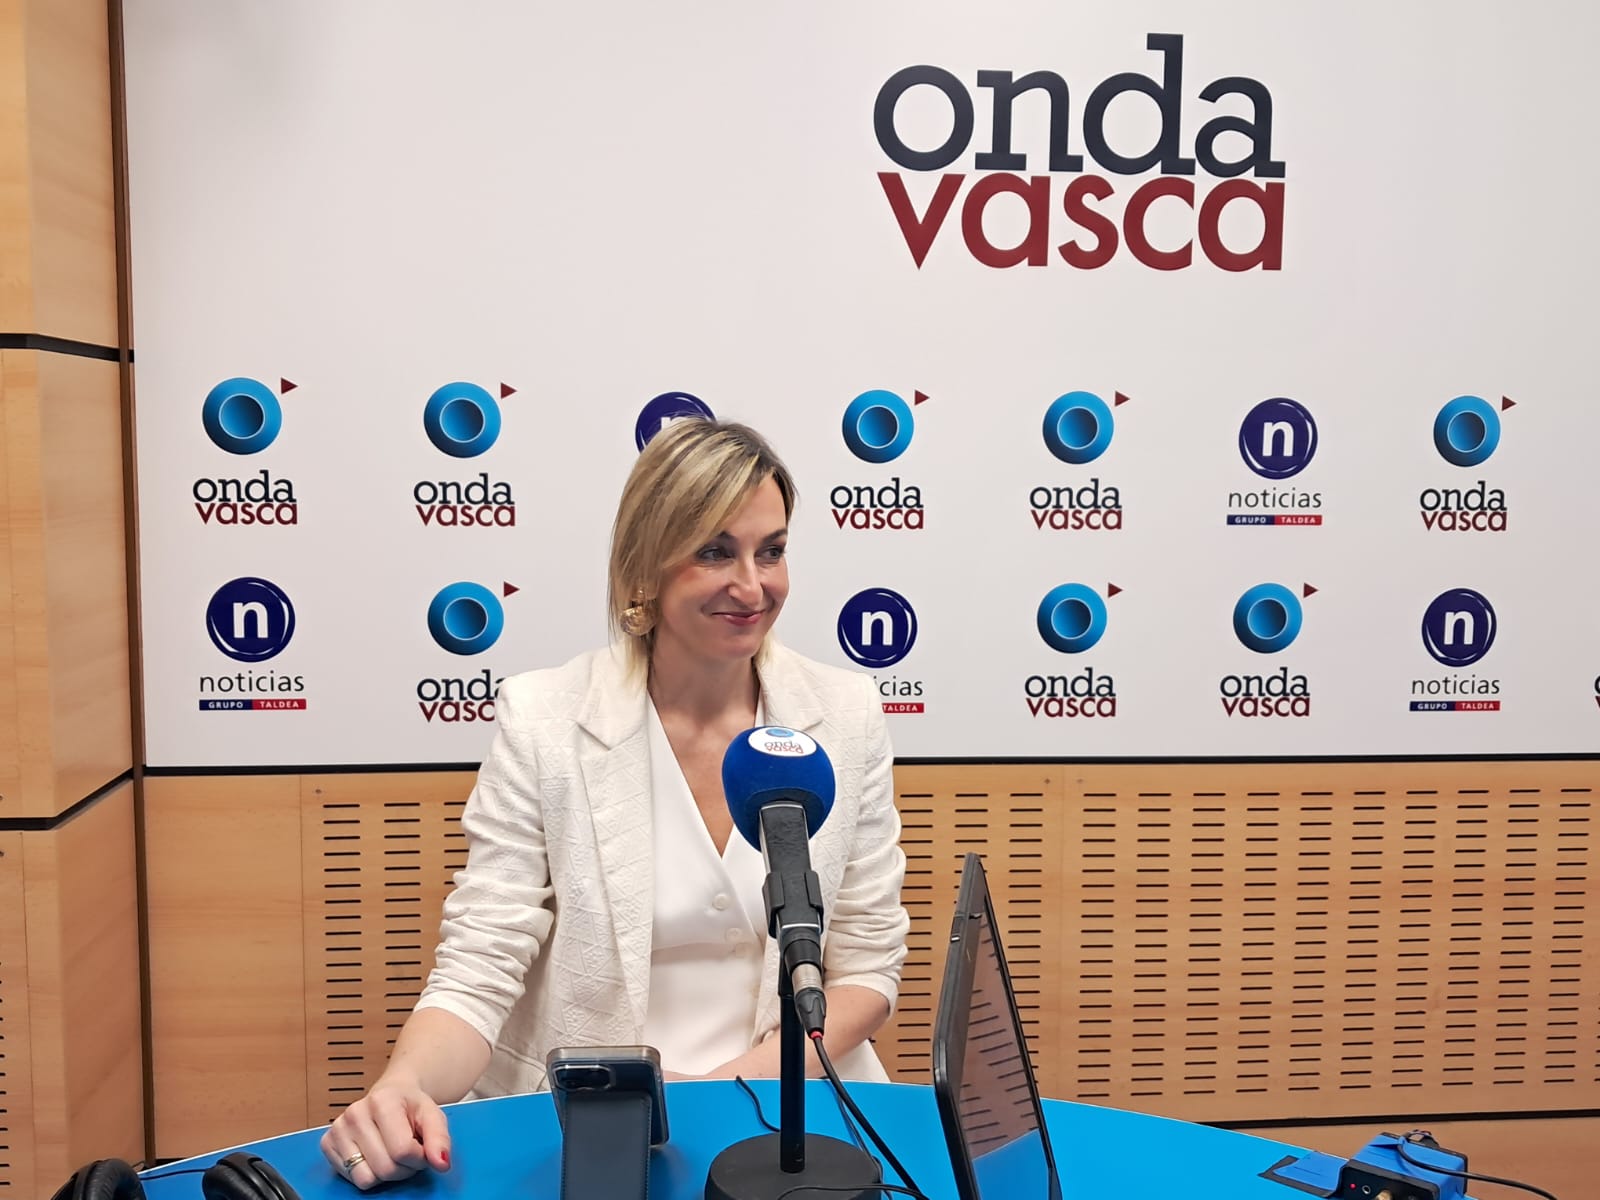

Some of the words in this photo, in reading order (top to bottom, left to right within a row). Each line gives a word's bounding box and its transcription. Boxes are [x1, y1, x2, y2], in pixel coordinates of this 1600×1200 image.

[873, 33, 1286, 178] onda
[877, 172, 1286, 272] vasca
[192, 470, 297, 502] onda
[414, 473, 515, 505] onda
[830, 478, 924, 508] onda
[1029, 479, 1122, 509] onda
[1228, 487, 1322, 508] noticias
[1419, 481, 1507, 511] onda
[194, 502, 298, 525] vasca
[416, 504, 516, 527] vasca
[831, 508, 924, 530] vasca
[1031, 509, 1122, 530] vasca
[1234, 516, 1267, 524] GRUPO
[1281, 516, 1316, 524] TALDEA
[1421, 511, 1507, 531] vasca
[200, 670, 304, 692] noticias
[416, 669, 504, 701] ond
[1024, 667, 1116, 698] onda
[1219, 667, 1310, 697] onda
[1412, 674, 1500, 694] noticias
[208, 701, 244, 709] GRUPO
[418, 700, 495, 723] vasc
[1026, 697, 1116, 718] vasca
[1221, 697, 1310, 717] vasca
